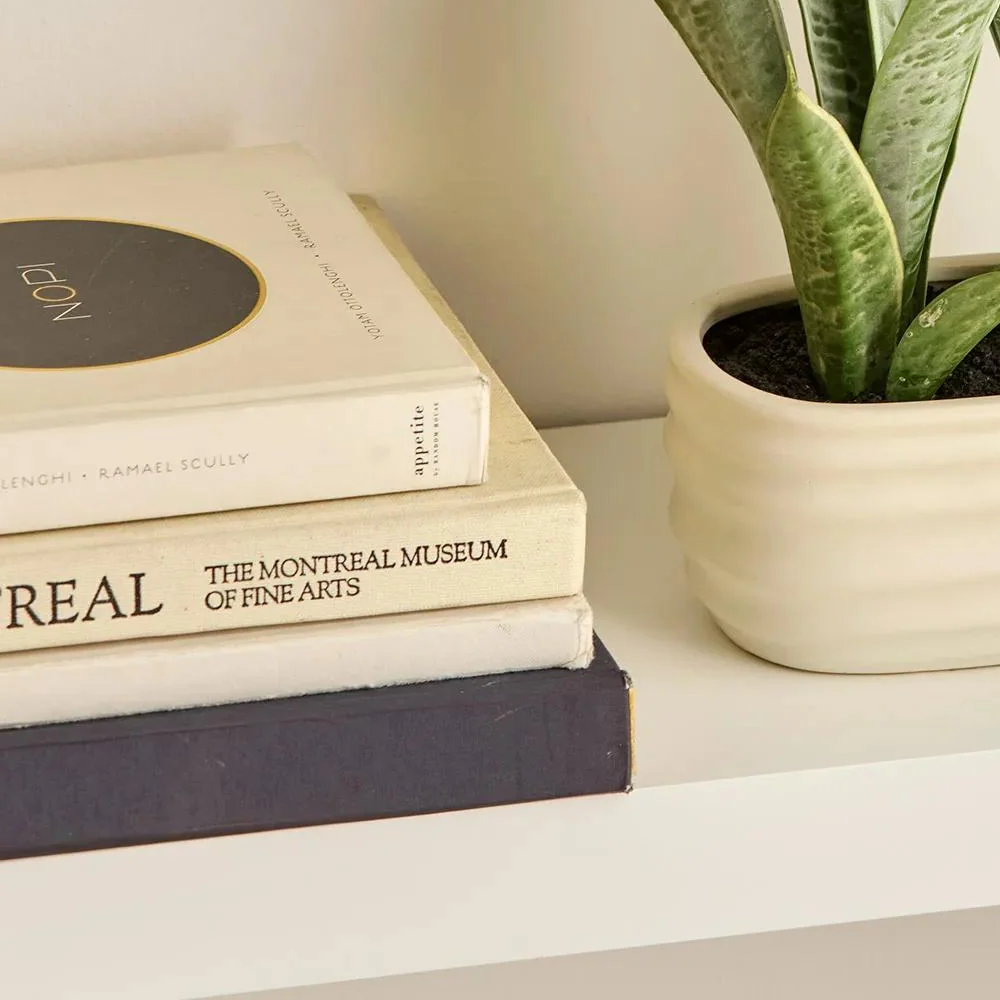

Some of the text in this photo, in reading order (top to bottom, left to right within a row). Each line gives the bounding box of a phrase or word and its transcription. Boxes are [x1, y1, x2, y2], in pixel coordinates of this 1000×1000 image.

[263, 190, 293, 217] SCULLY
[16, 262, 92, 321] NOPI
[410, 404, 429, 476] appetite
[99, 461, 173, 480] RAMAEL
[180, 452, 250, 470] SCULLY
[204, 538, 509, 586] THE MONTREAL MUSEUM
[0, 572, 164, 630] REAL
[204, 576, 362, 613] OF FINE ARTS
